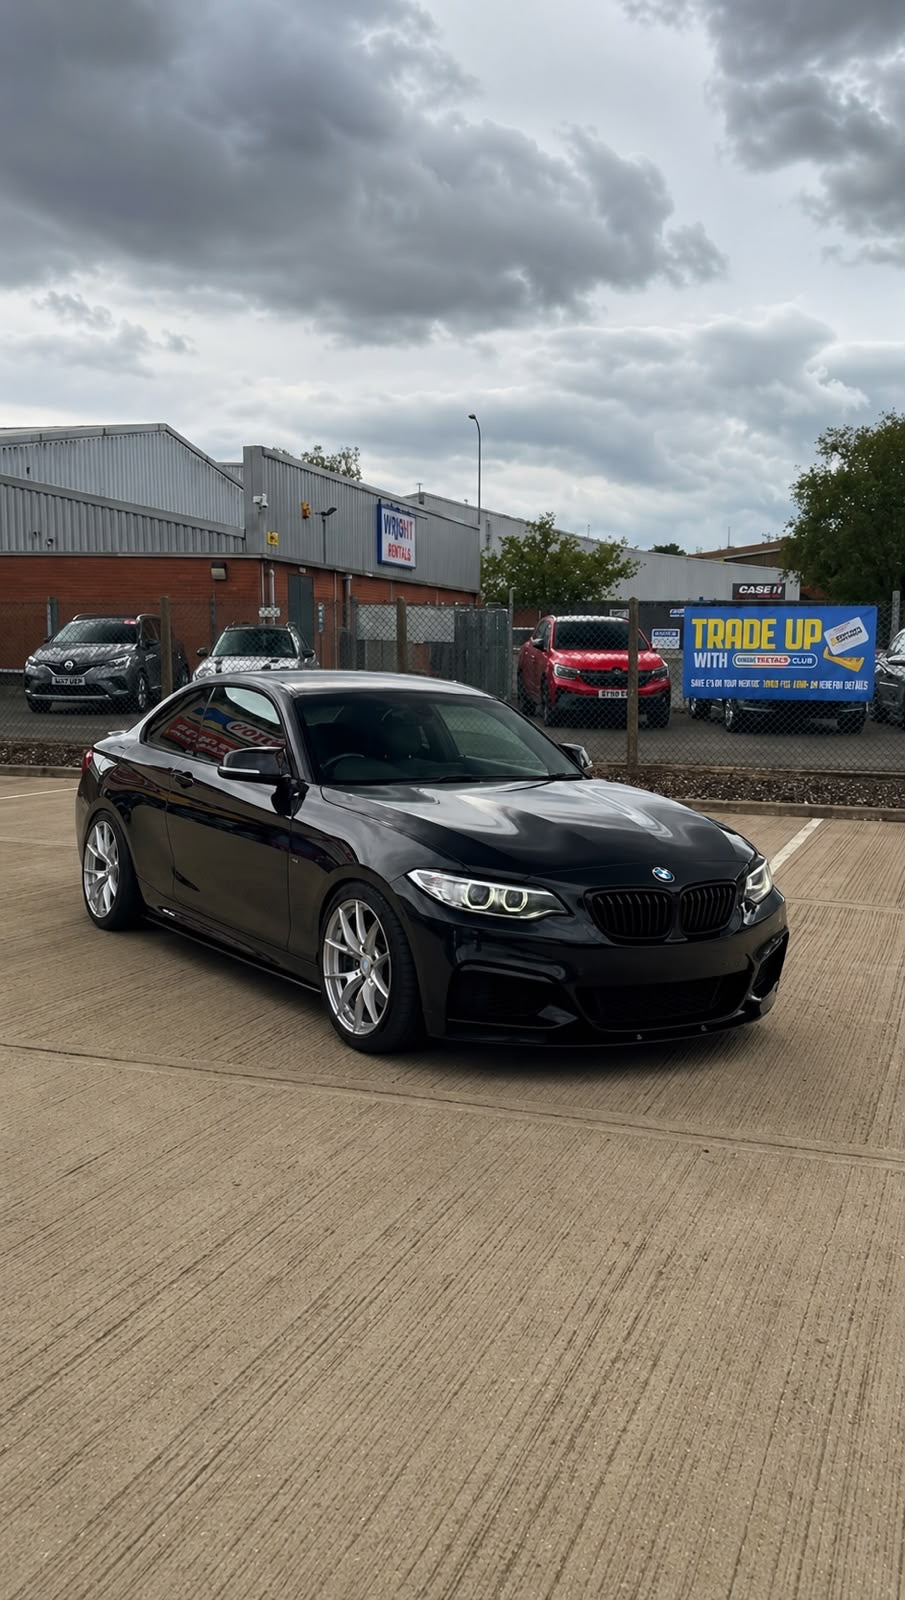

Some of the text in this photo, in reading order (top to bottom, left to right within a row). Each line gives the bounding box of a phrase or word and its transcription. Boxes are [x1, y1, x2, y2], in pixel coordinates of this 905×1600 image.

[388, 543, 411, 561] RENTALS
[739, 585, 772, 594] CASE
[691, 618, 777, 650] TRADE
[785, 618, 823, 650] UP
[694, 652, 728, 668] WITH
[792, 656, 813, 665] CLUB
[844, 681, 868, 690] DETAILS
